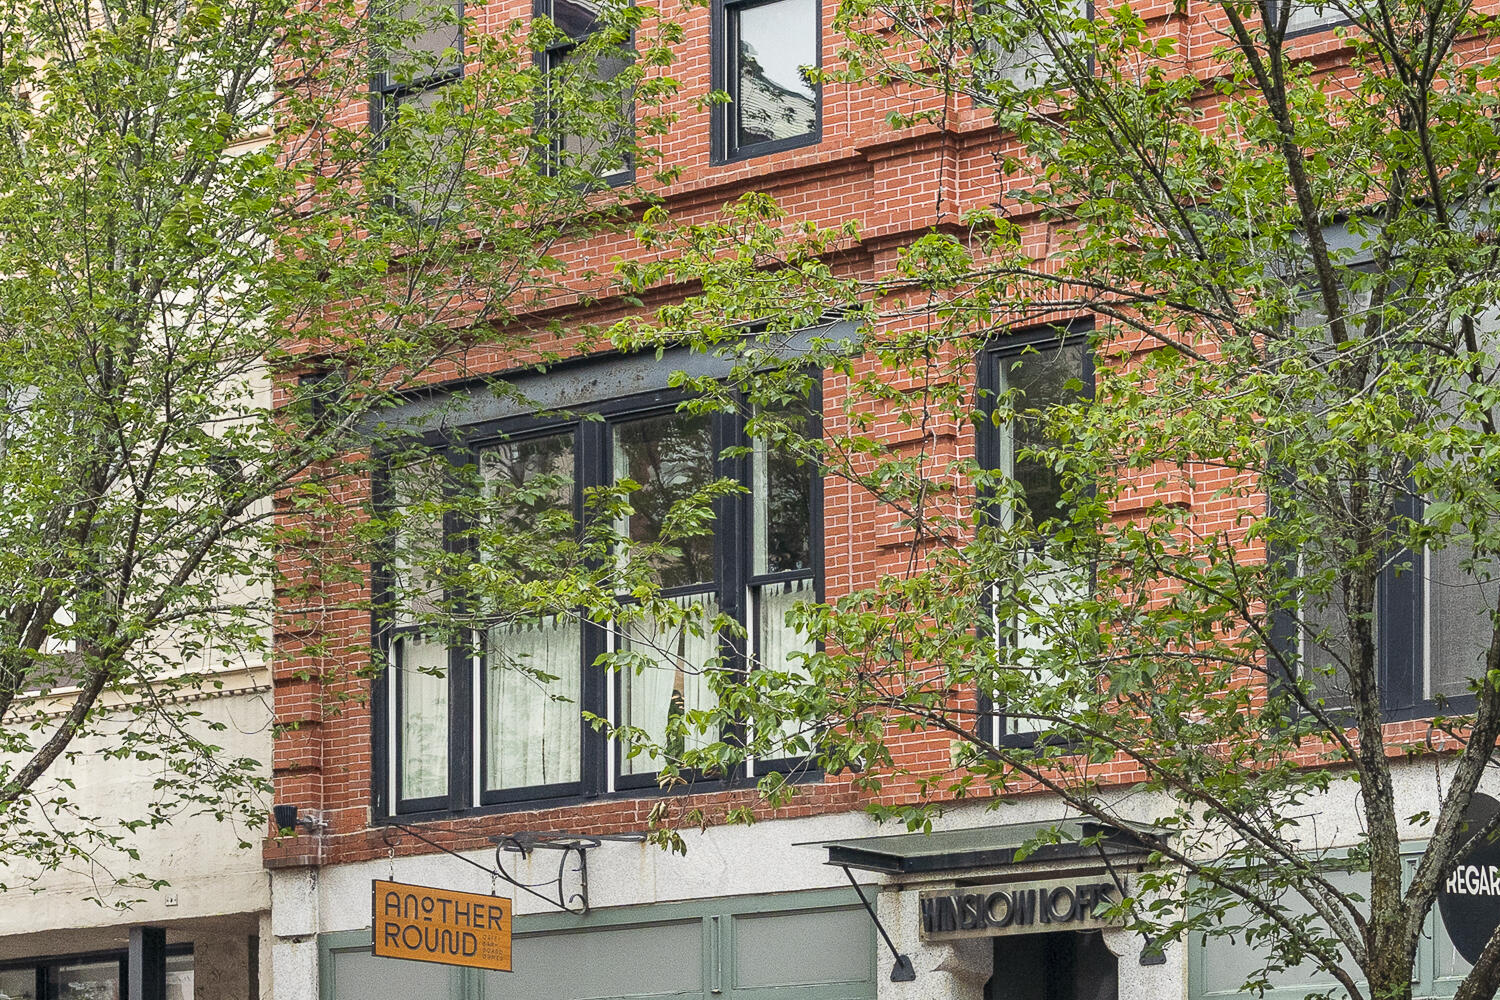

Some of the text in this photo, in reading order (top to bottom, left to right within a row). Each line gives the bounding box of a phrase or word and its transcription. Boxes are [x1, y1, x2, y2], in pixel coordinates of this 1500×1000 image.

[385, 891, 504, 931] ANOTHER
[920, 889, 1036, 932] WINSLOW
[385, 922, 478, 957] ROUND
